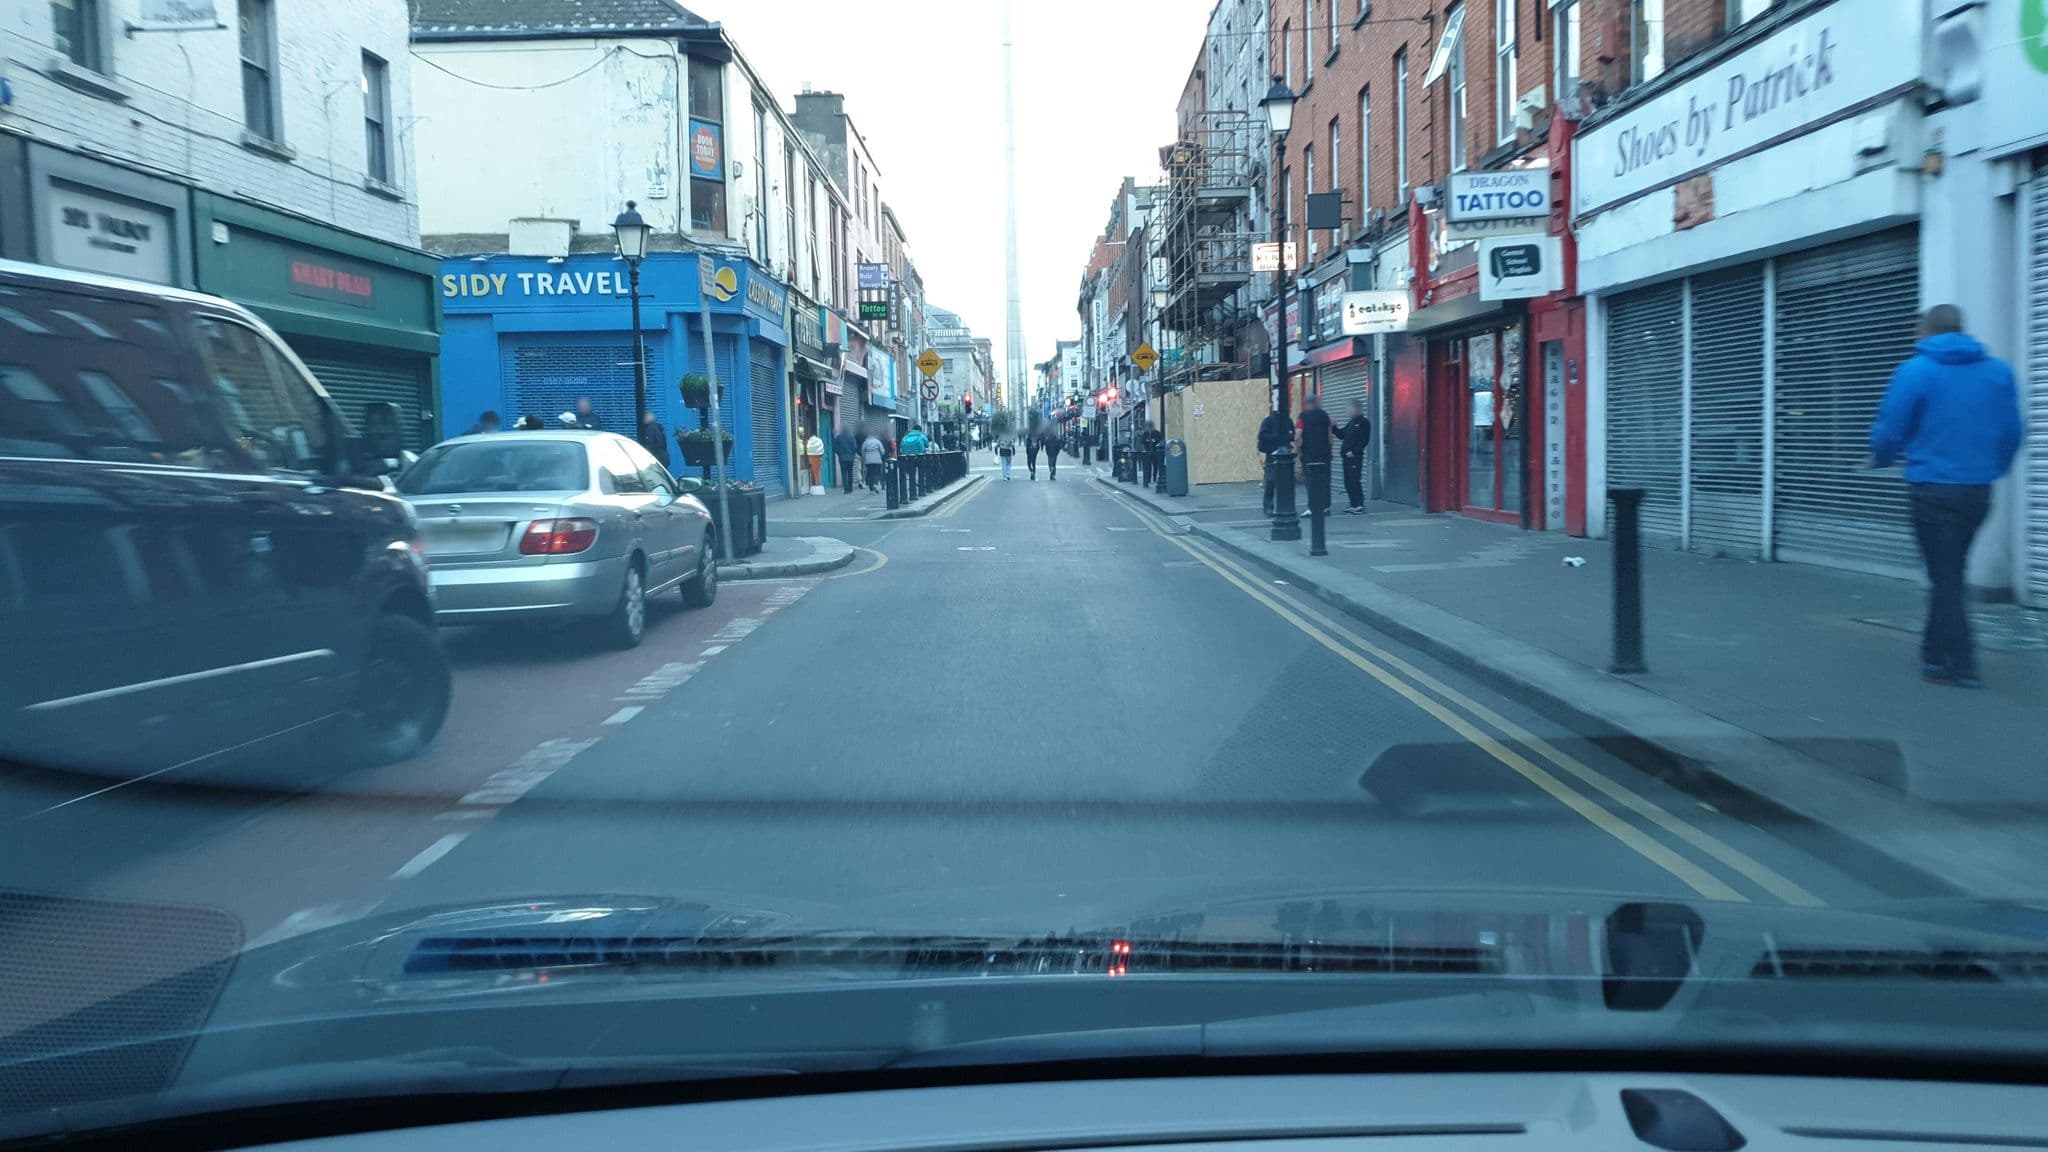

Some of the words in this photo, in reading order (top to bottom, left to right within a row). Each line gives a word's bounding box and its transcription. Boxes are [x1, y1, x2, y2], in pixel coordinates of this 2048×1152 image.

[1614, 122, 1680, 178] Shoes
[1686, 95, 1717, 157] by
[1723, 26, 1837, 132] Patrick
[1470, 174, 1528, 188] DRAGON
[1457, 190, 1543, 211] TATTOO
[517, 271, 629, 296] TRAVEL
[861, 304, 886, 313] Tattoo
[890, 283, 898, 329] TATTOO
